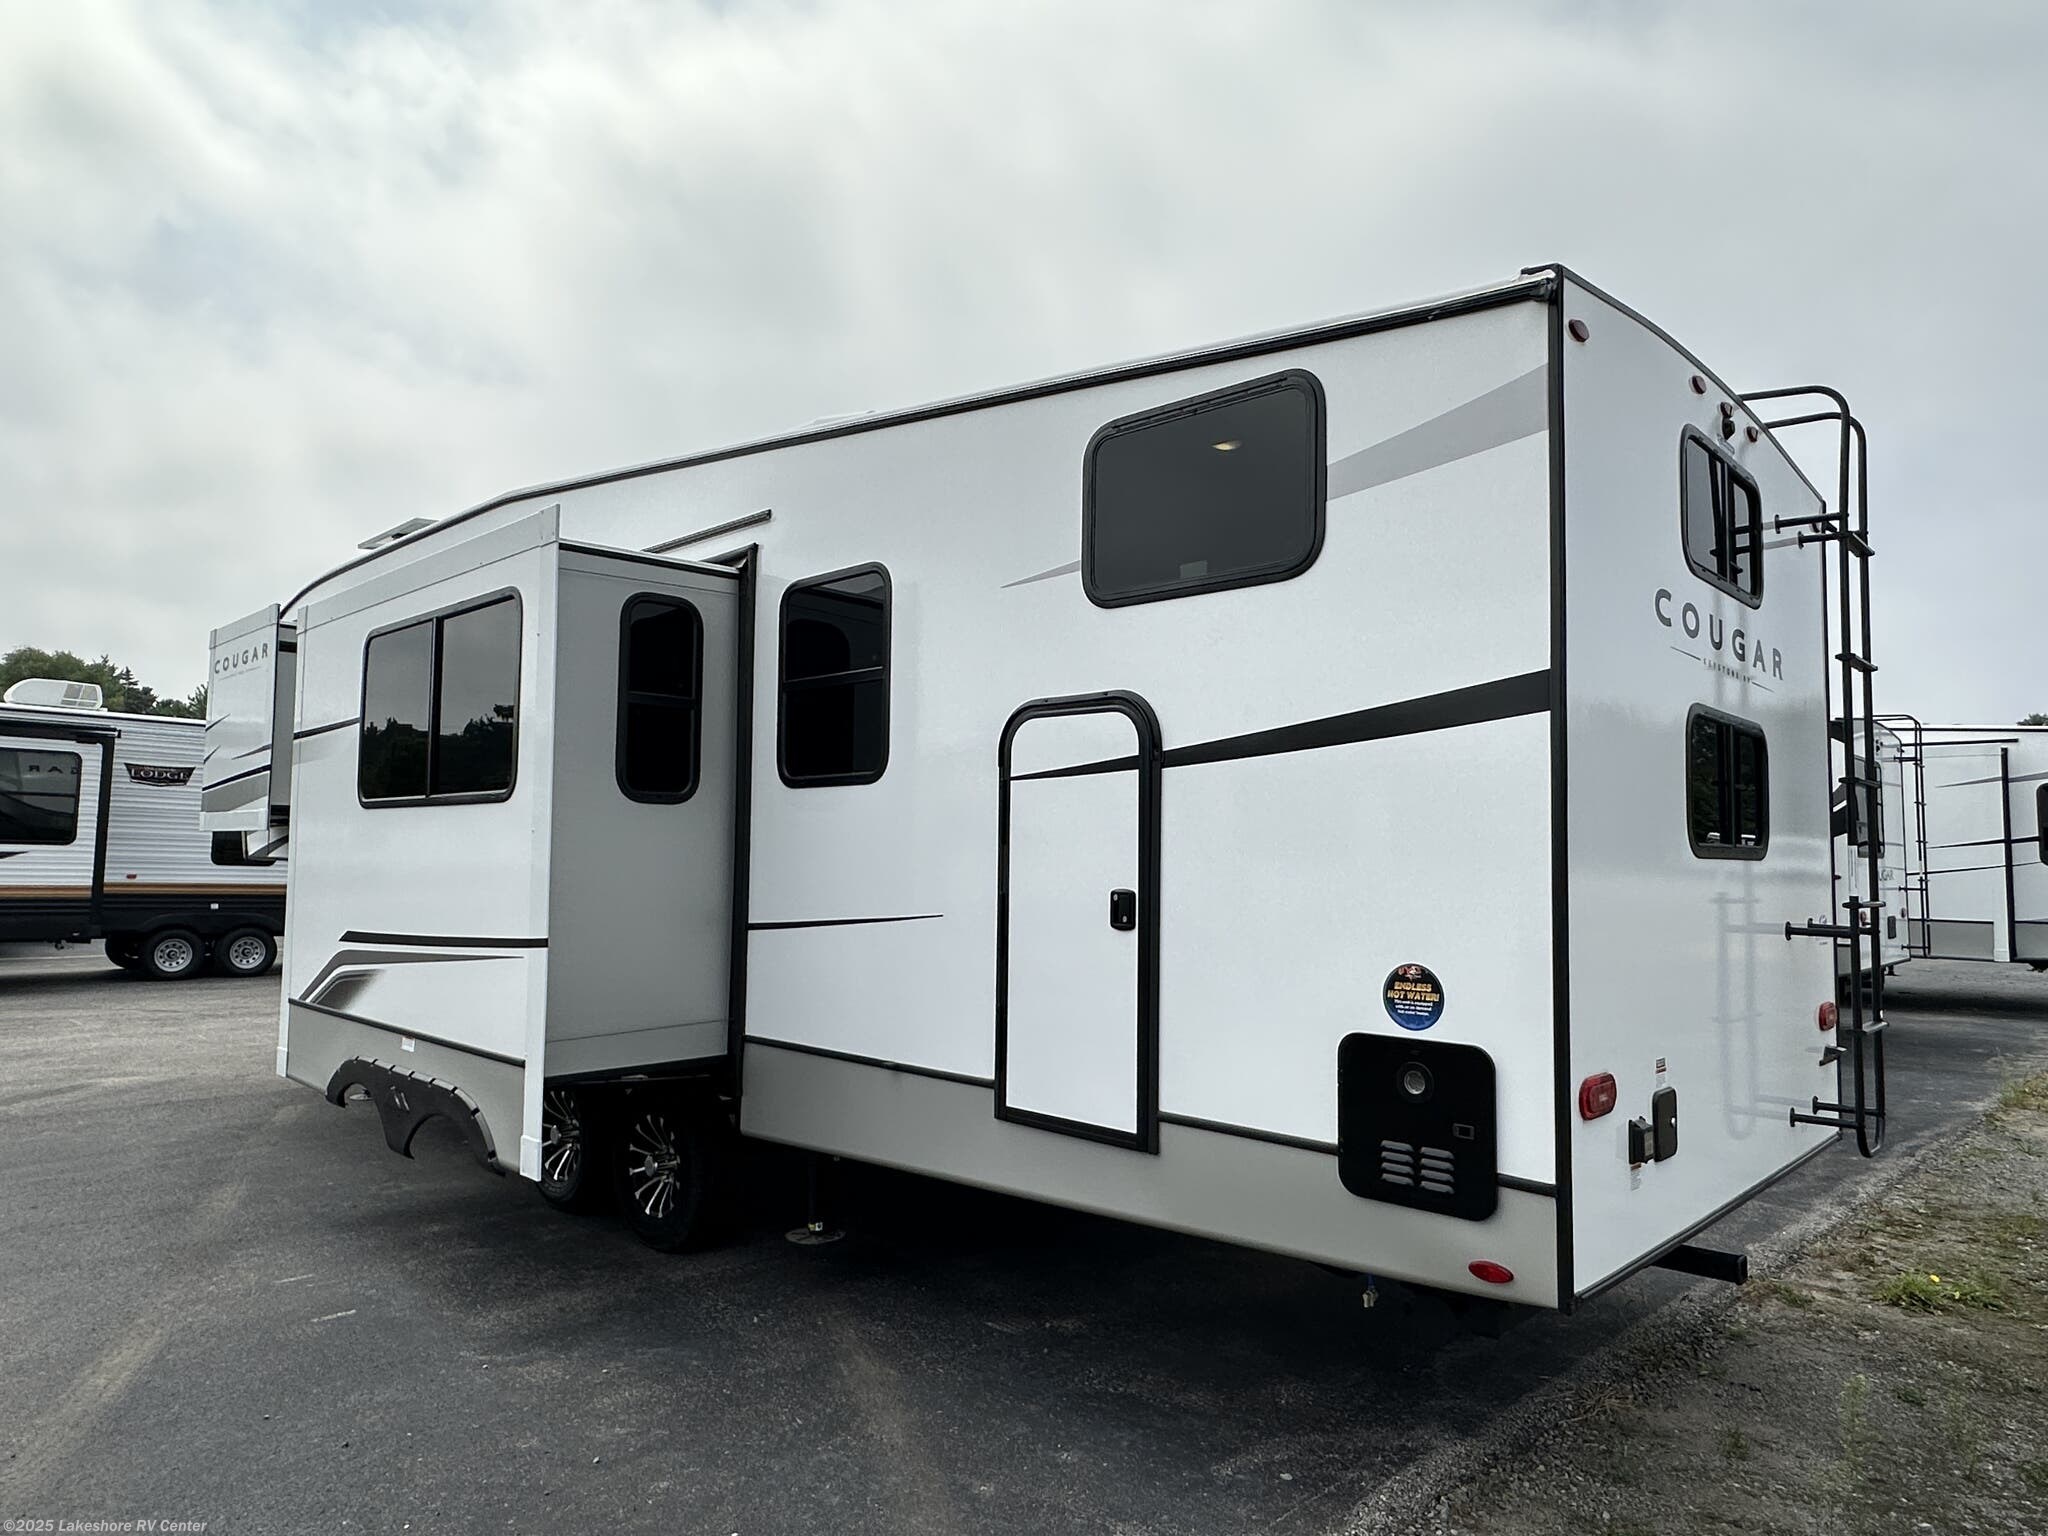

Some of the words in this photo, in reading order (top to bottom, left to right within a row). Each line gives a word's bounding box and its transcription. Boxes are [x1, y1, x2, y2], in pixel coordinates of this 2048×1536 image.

[1655, 588, 1783, 681] COUGAR
[214, 642, 268, 674] COUGAR
[131, 767, 190, 780] LODGE
[1394, 981, 1432, 992] ENDLESS
[1387, 990, 1405, 999] HOT
[1406, 991, 1440, 1002] WATER!
